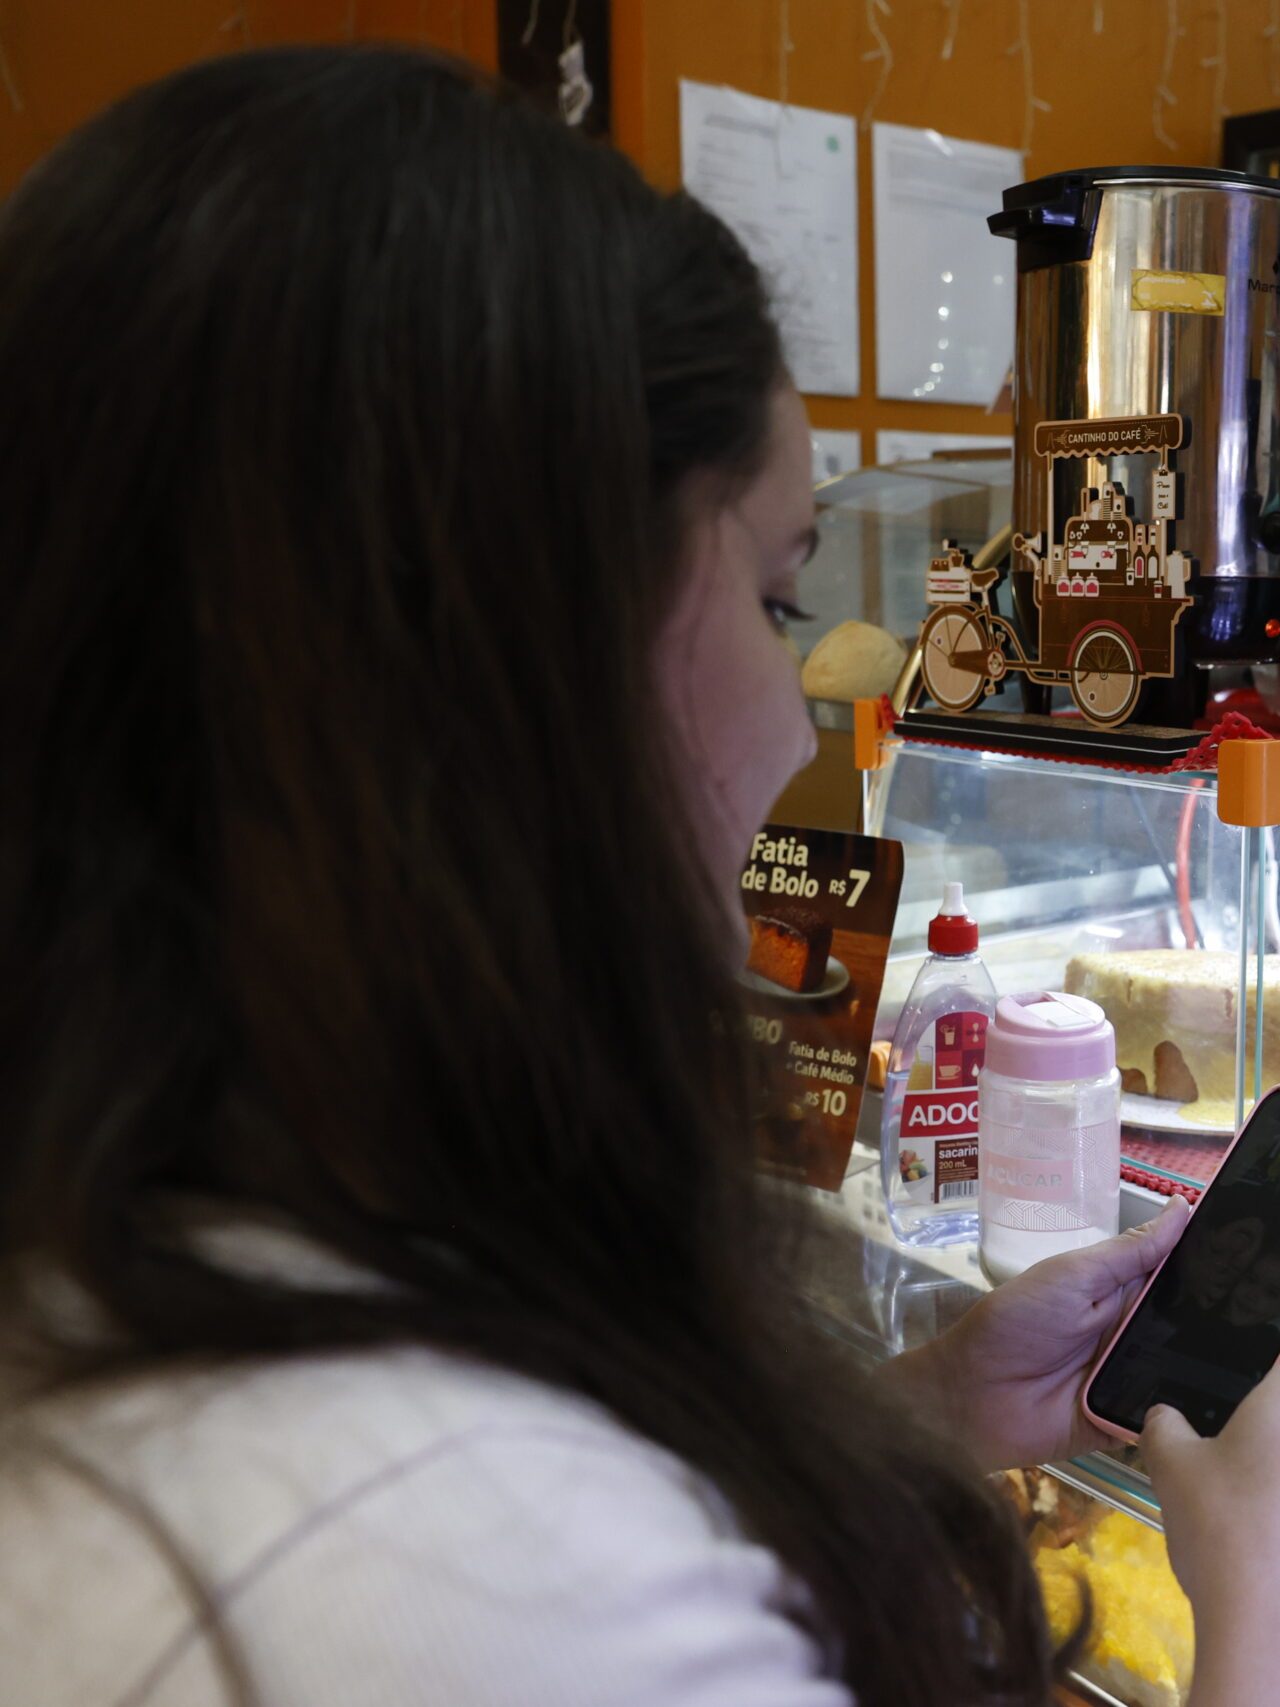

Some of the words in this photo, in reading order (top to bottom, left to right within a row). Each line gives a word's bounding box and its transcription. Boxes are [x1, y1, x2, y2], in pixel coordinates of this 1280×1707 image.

[1068, 432, 1107, 445] CANTINHO
[1108, 431, 1119, 441] DO
[1120, 428, 1142, 441] CAFÉ
[750, 832, 809, 868] Fatia
[741, 864, 768, 892] de
[769, 866, 820, 899] Bolo
[828, 878, 848, 897] R$
[845, 868, 872, 908] 7
[789, 1041, 815, 1059] Fatia
[816, 1046, 830, 1062] de
[831, 1049, 857, 1068] Bolo
[794, 1061, 819, 1078] Café
[819, 1065, 855, 1085] Médio
[803, 1091, 820, 1107] R$
[821, 1088, 847, 1117] 10
[938, 1160, 954, 1170] 200
